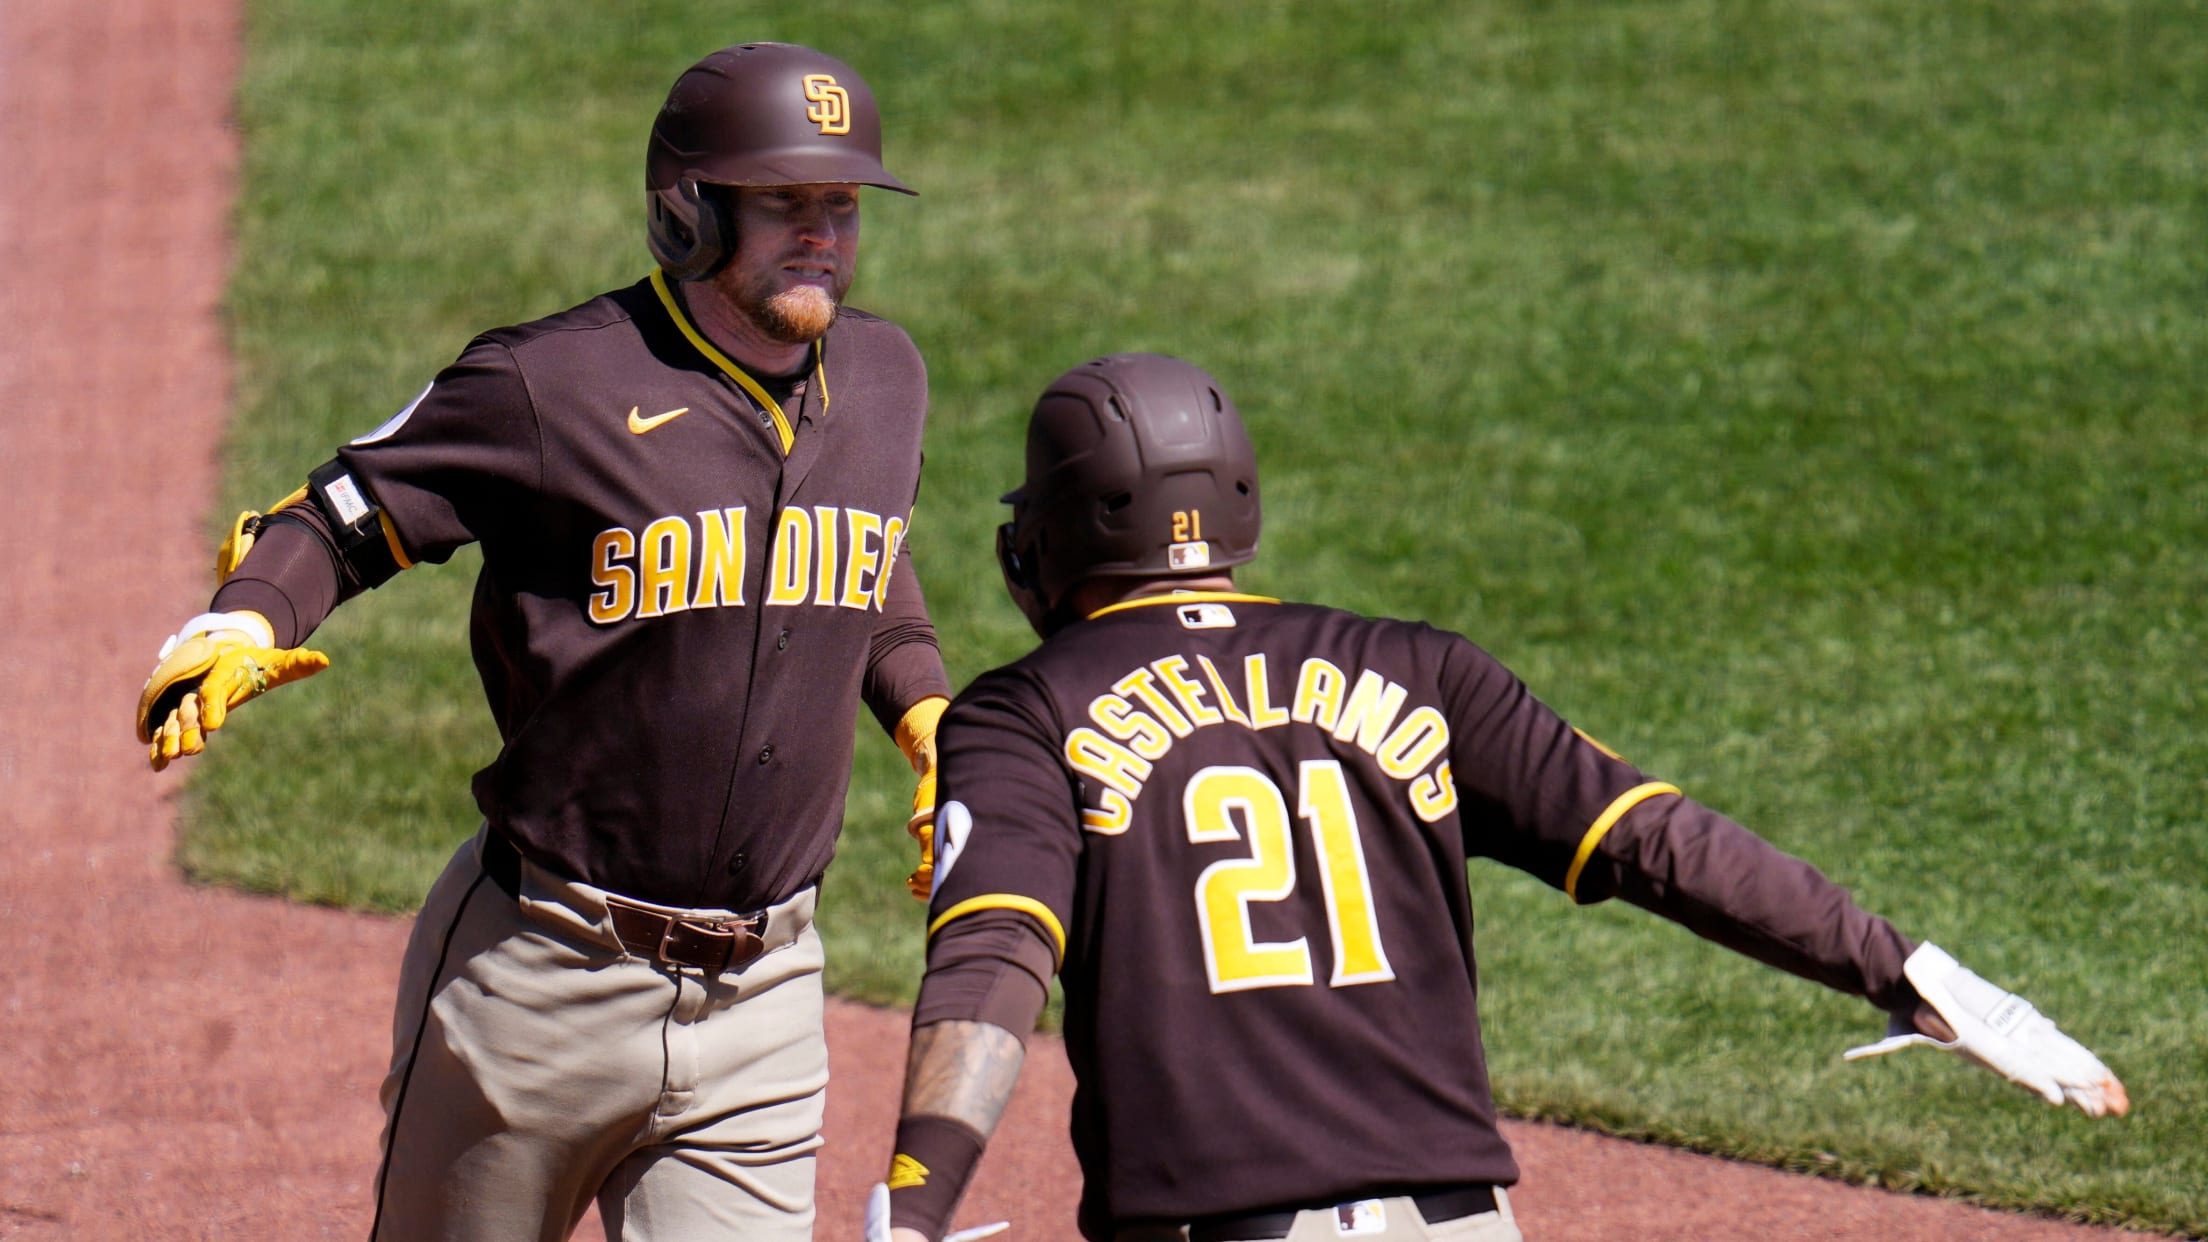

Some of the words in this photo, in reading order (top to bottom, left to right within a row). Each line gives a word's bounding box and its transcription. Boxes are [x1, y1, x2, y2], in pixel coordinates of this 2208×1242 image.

[802, 74, 851, 136] SD
[588, 506, 747, 625] SAN
[1171, 509, 1202, 542] 21
[1063, 653, 1459, 836] CASTELLANOS
[1182, 759, 1396, 995] 21
